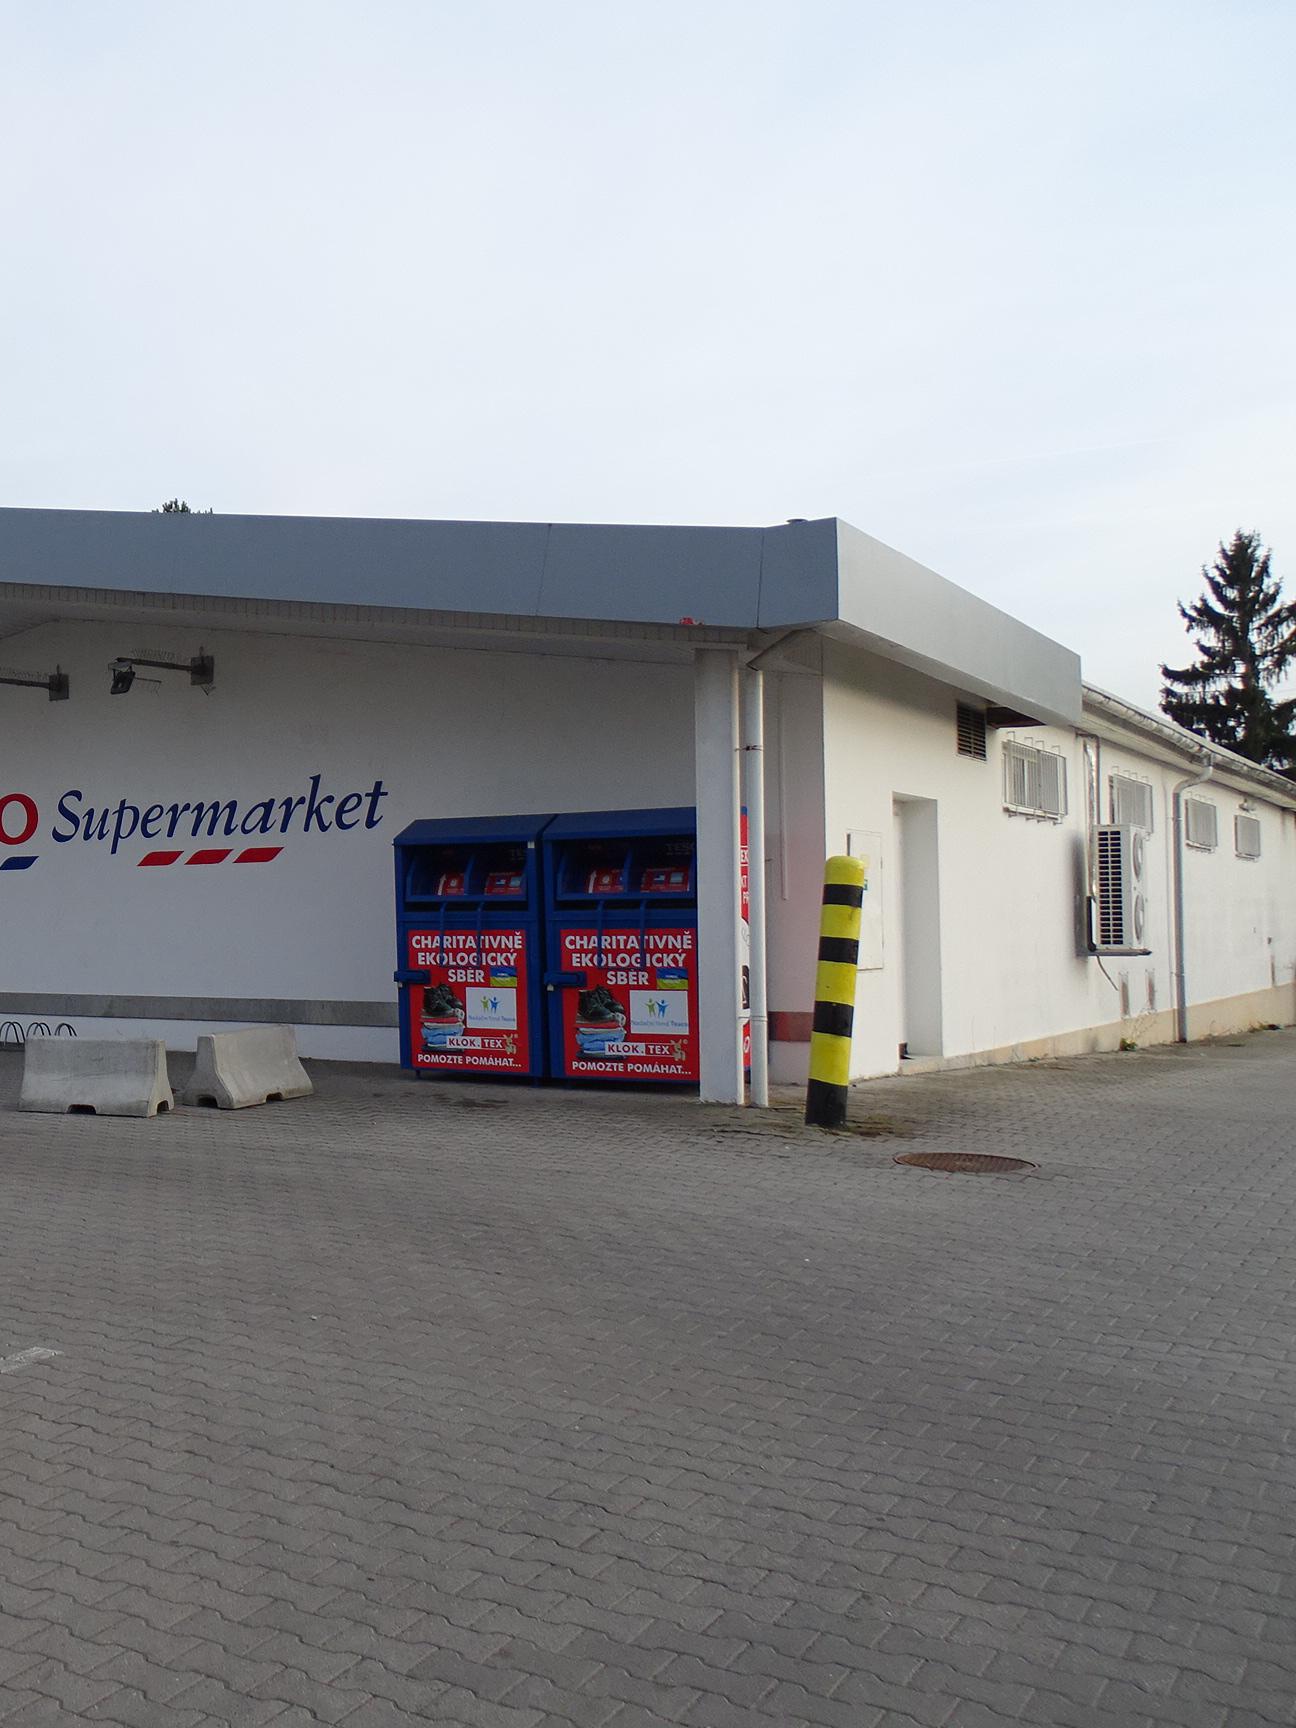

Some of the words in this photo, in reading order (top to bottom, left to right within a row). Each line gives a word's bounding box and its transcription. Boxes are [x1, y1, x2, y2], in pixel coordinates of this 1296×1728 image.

[52, 775, 388, 854] Supermarket
[484, 1039, 502, 1048] TEX
[648, 1045, 670, 1055] TEX
[418, 1054, 463, 1065] POMOZTE
[572, 1062, 624, 1072] POMOZTE
